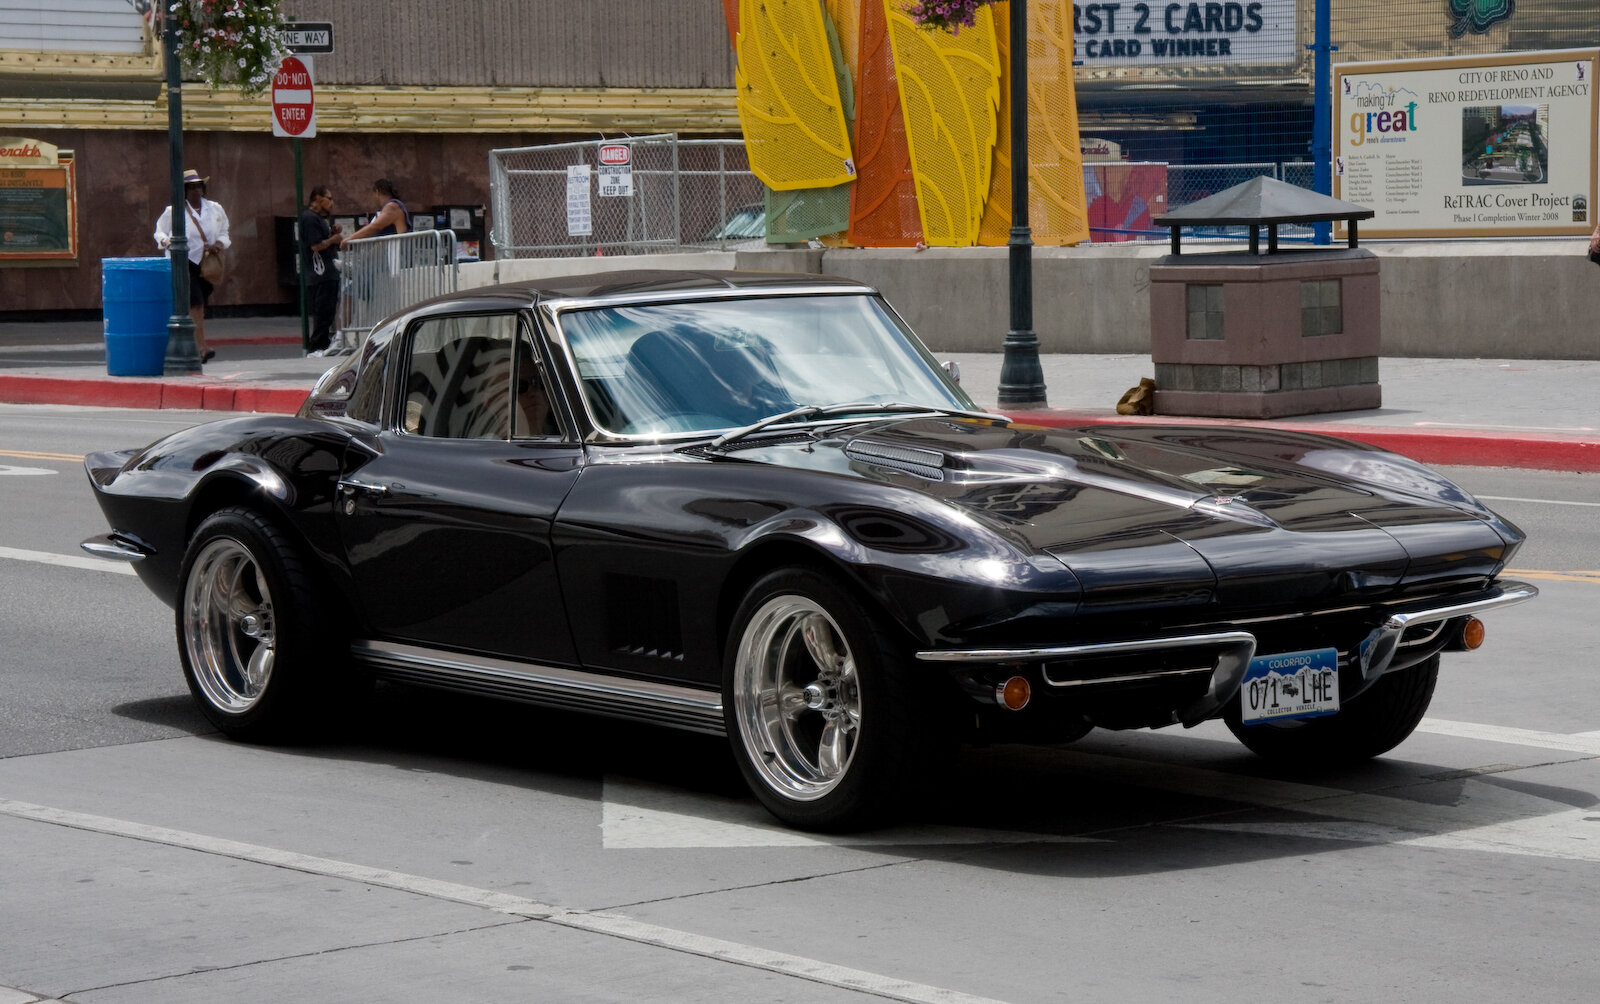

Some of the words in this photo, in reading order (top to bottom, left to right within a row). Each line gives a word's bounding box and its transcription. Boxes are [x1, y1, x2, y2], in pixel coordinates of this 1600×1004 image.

[1134, 3, 1151, 34] 2
[1165, 2, 1263, 34] CARDS
[305, 32, 326, 44] WAY
[1085, 39, 1142, 58] CARD
[1151, 38, 1232, 57] WINNER
[1459, 72, 1482, 84] CITY
[1484, 71, 1498, 83] OF
[1500, 70, 1528, 82] RENO
[1531, 68, 1553, 80] AND
[1428, 91, 1456, 104] RENO
[1458, 86, 1545, 103] REDEVELOPMENT
[1547, 84, 1589, 98] AGENCY
[1357, 94, 1385, 110] making
[1387, 94, 1396, 106] it
[282, 108, 306, 121] ENTER
[1350, 101, 1418, 146] great
[602, 149, 628, 161] DANGER
[599, 167, 631, 175] CONSTRUCTION
[611, 176, 621, 184] ZONE
[603, 186, 617, 195] KEEP
[618, 186, 628, 195] OUT
[1444, 194, 1492, 209] ReTRAC
[1496, 193, 1527, 208] Cover
[1532, 192, 1570, 210] Project
[1454, 213, 1471, 223] Phase
[1478, 213, 1515, 225] Completion
[1517, 212, 1540, 222] Winter
[1542, 212, 1559, 222] 2008
[1269, 656, 1312, 668] COLORADO
[1250, 678, 1279, 711] 071
[1302, 672, 1333, 704] LHE
[1267, 706, 1292, 715] COLLECTOR
